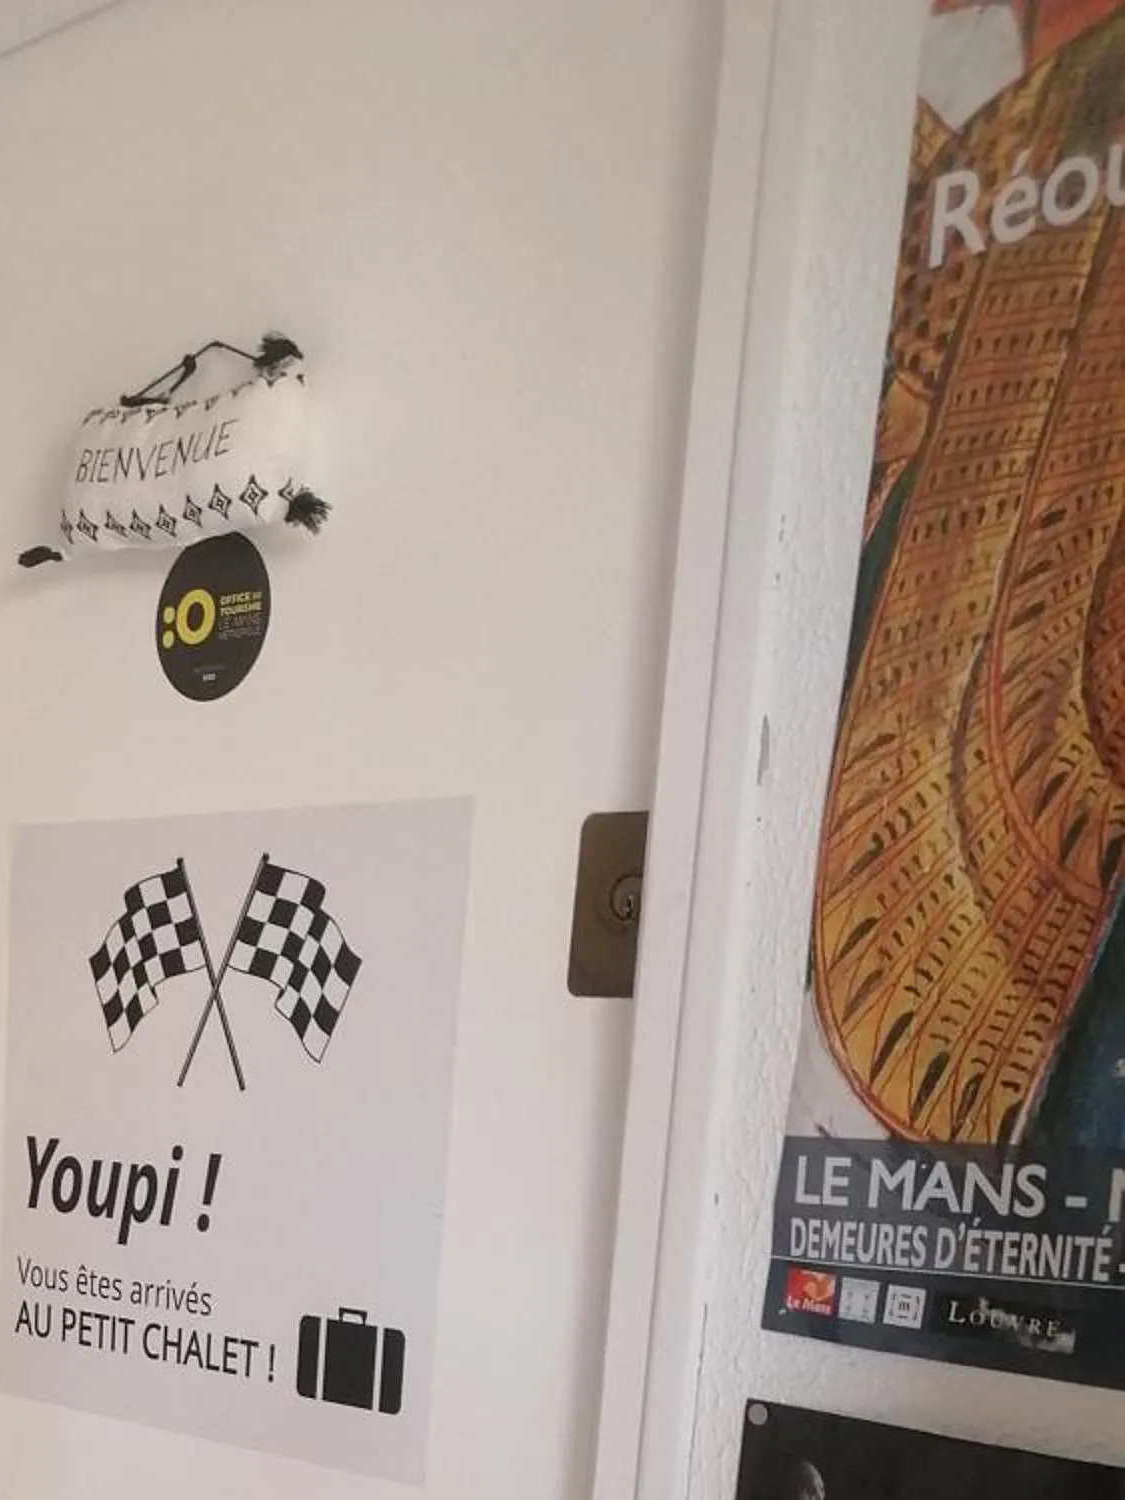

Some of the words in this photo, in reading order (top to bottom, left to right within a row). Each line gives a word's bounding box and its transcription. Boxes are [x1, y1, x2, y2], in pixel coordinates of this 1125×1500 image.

[75, 418, 240, 484] BIENVENUE
[26, 1135, 184, 1246] Youpi
[196, 1153, 223, 1233] !
[794, 1155, 852, 1208] LE
[868, 1158, 1048, 1219] MANS
[789, 1216, 929, 1269] DEMEURES
[17, 1256, 69, 1293] Vous
[75, 1265, 123, 1302] êtes
[130, 1279, 213, 1317] arrivés
[14, 1300, 52, 1339] AU
[61, 1308, 135, 1355] PETIT
[142, 1323, 259, 1379] CHALET
